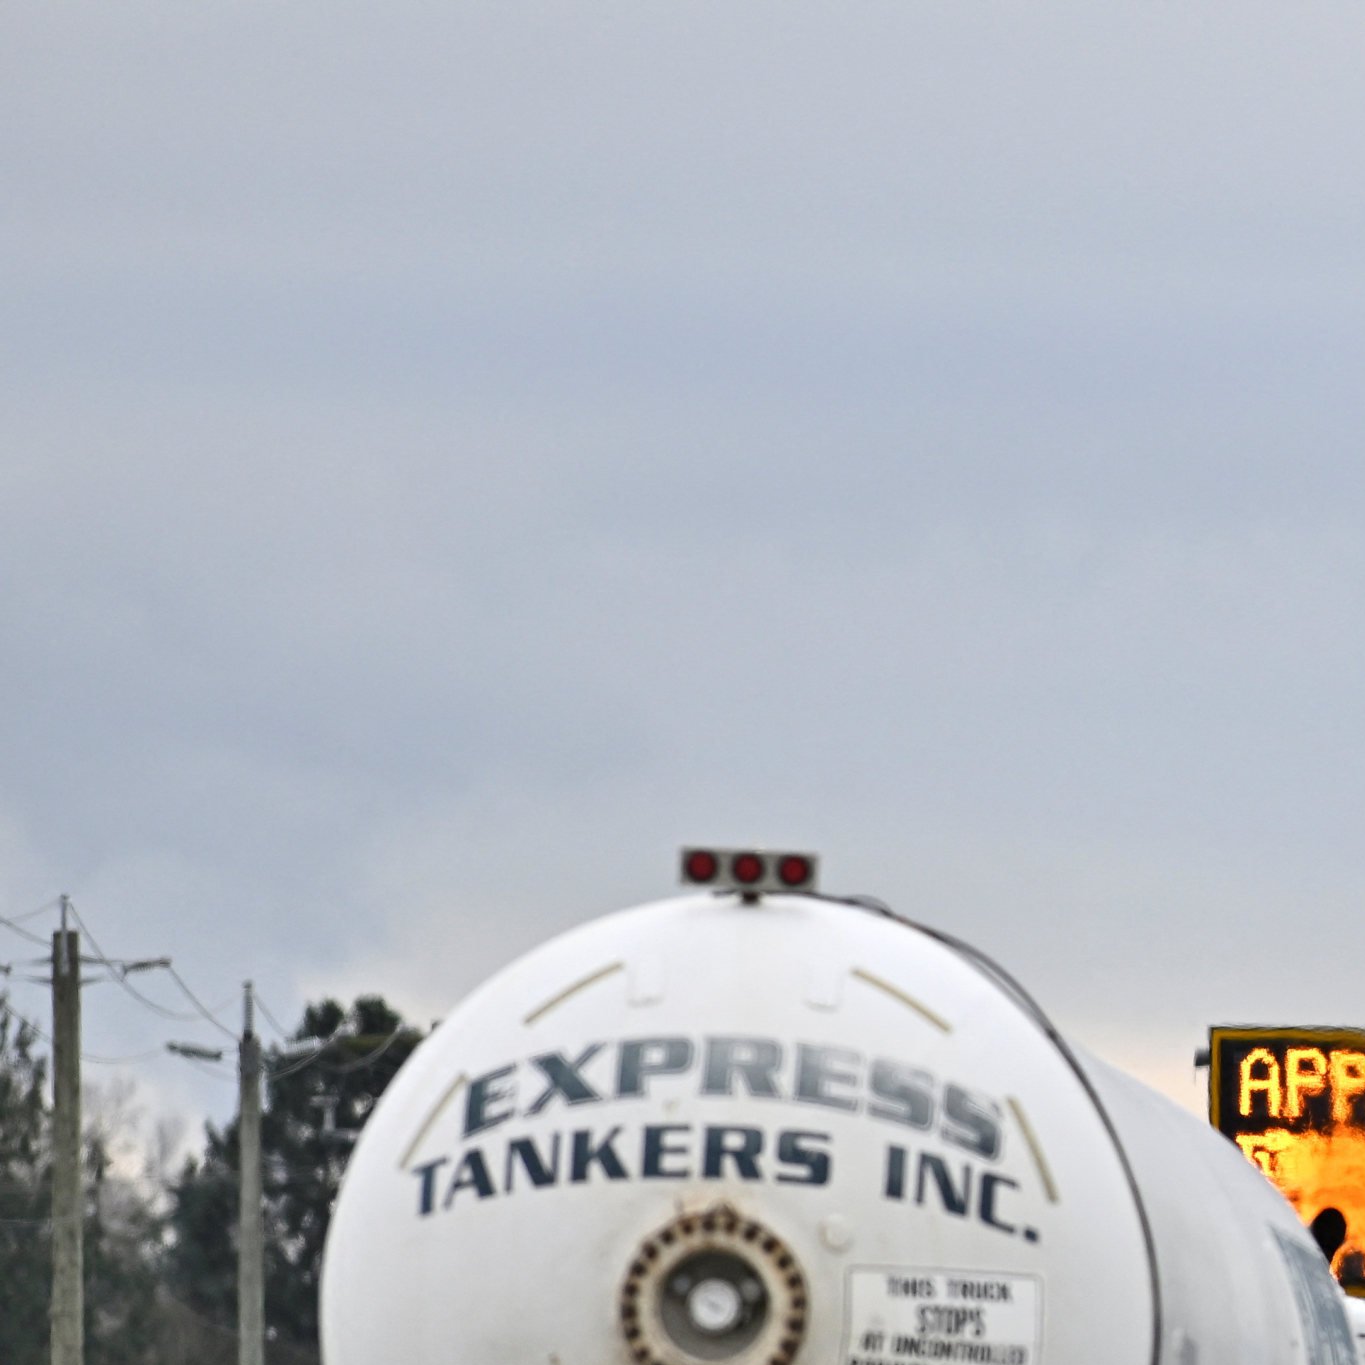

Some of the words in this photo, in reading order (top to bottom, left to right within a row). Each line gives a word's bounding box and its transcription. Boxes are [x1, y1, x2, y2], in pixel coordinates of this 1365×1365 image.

[462, 1036, 1003, 1162] EXPRESS
[412, 1124, 832, 1219] TANKERS
[883, 1144, 1040, 1243] INC.
[916, 1303, 986, 1339] STOPS
